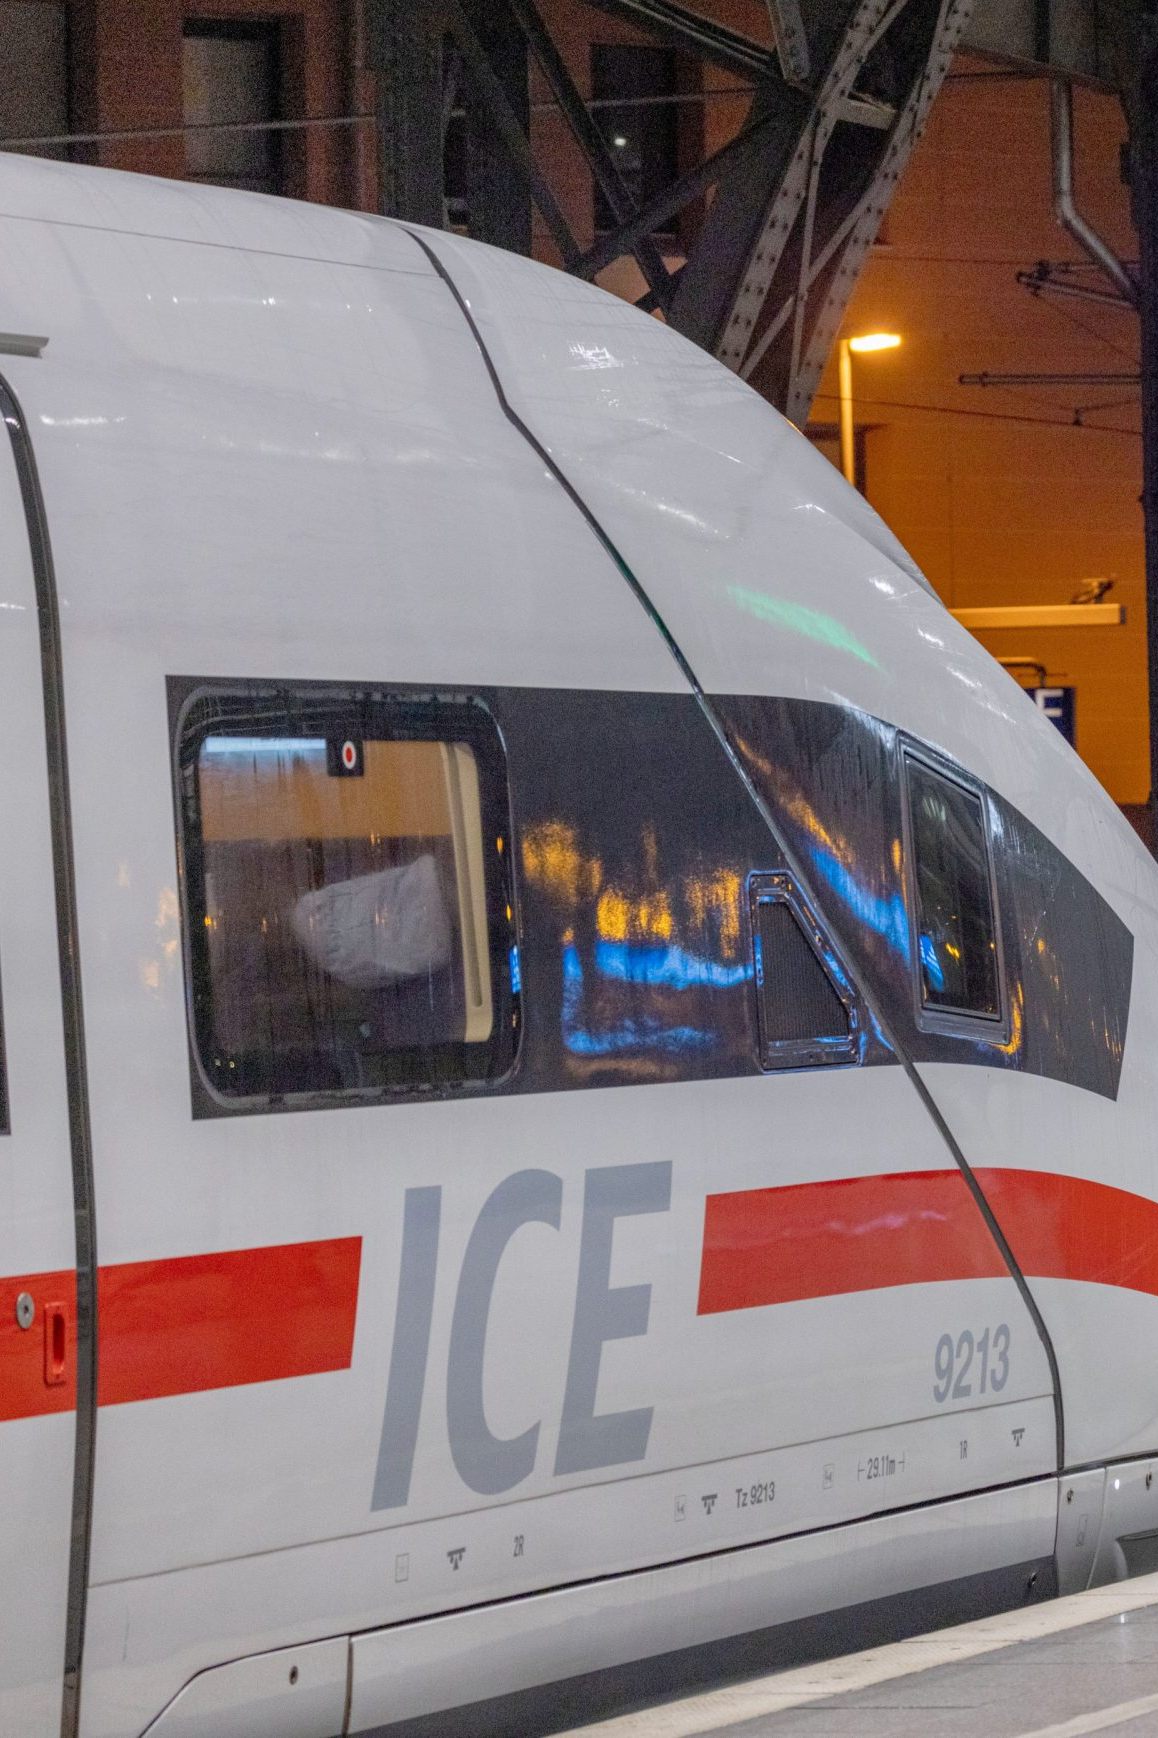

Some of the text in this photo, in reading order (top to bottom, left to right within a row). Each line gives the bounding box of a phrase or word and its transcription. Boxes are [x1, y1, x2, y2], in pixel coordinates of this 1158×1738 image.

[370, 1160, 673, 1513] ICE
[933, 1323, 1011, 1404] 9213
[735, 1481, 776, 1509] Tz 9213
